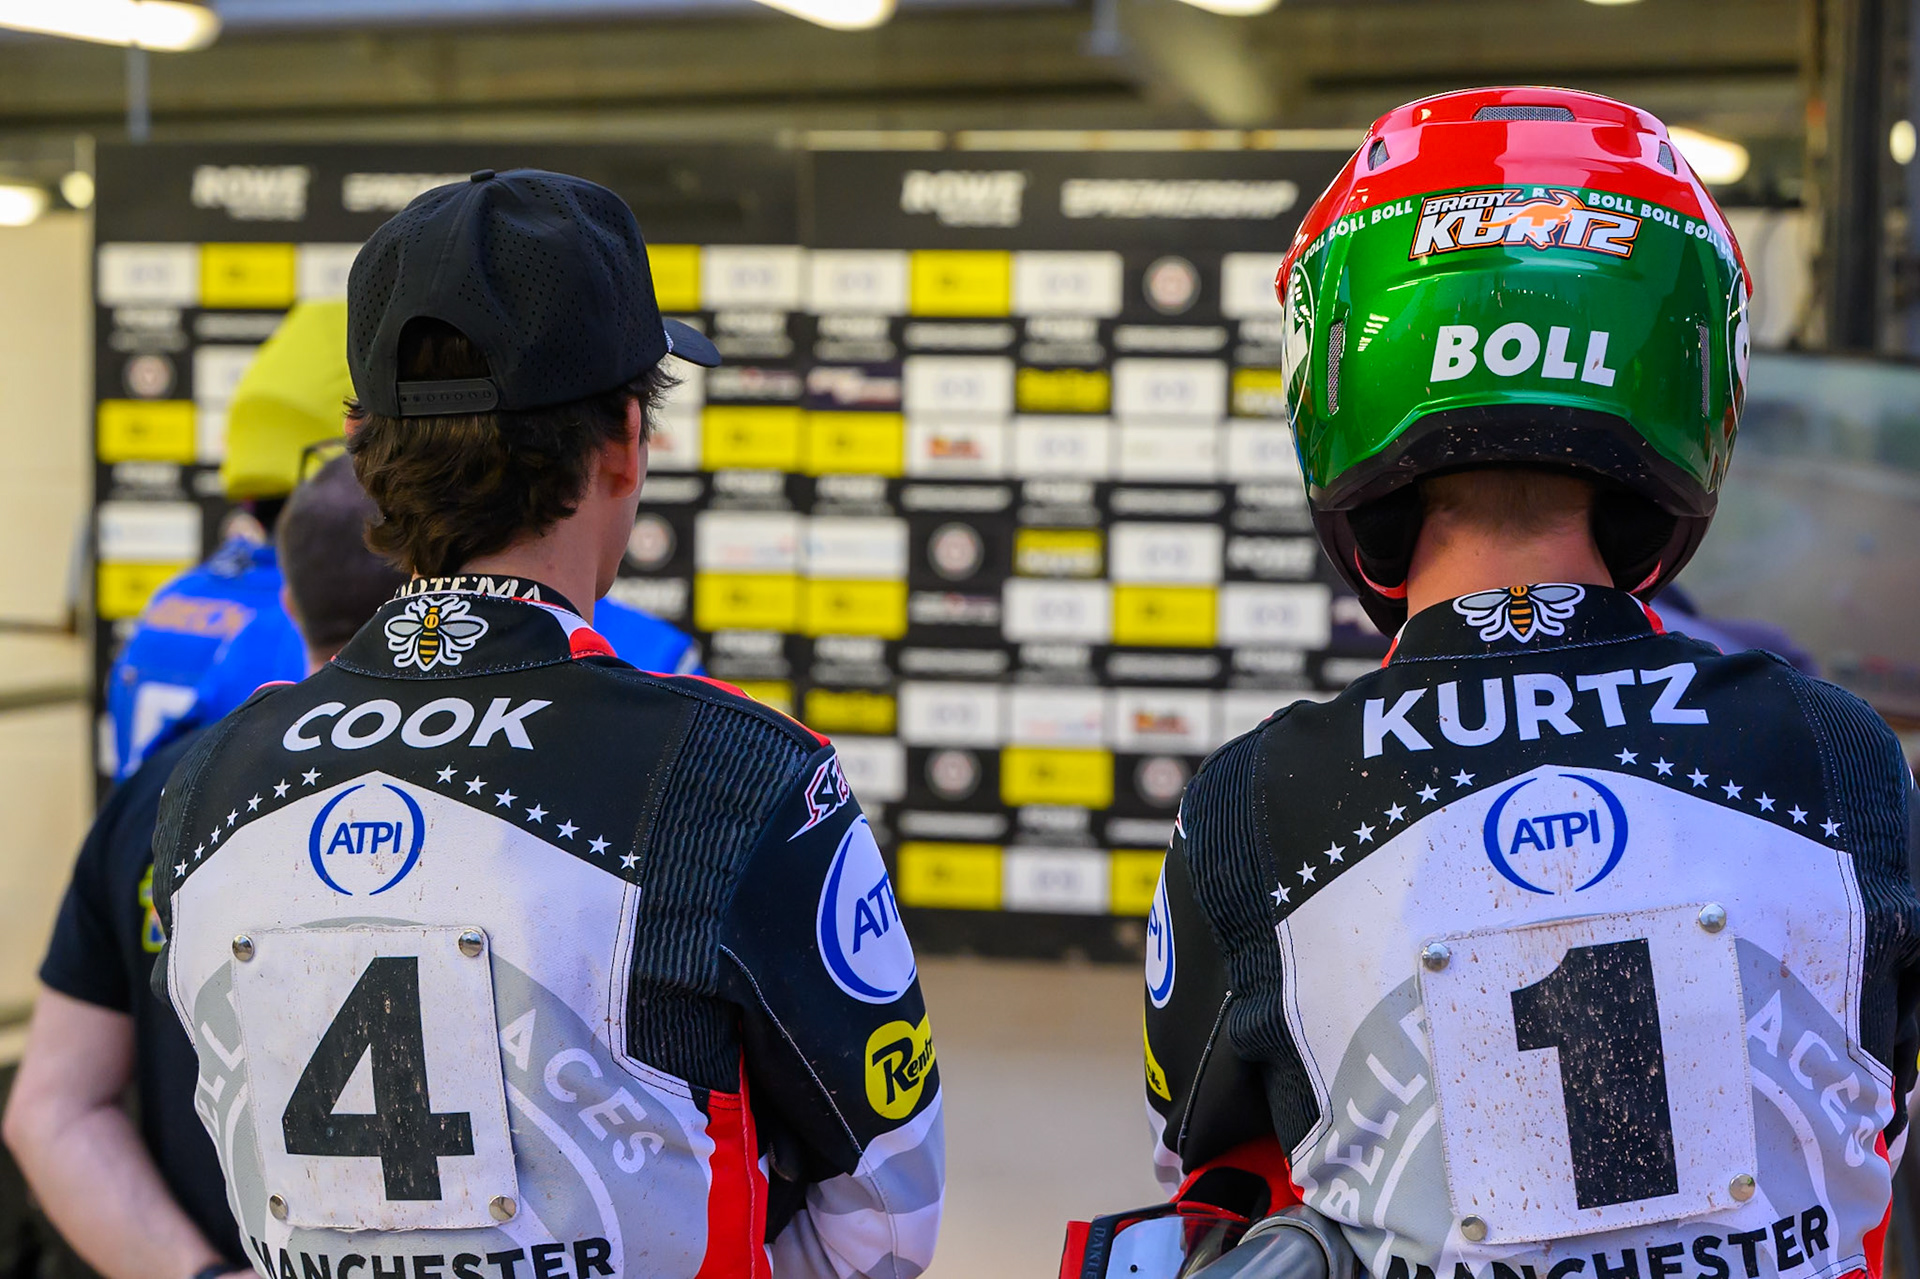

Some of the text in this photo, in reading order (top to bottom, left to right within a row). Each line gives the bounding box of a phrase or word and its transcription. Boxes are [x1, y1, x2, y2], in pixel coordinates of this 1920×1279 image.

[1328, 215, 1366, 242] BOLL
[1371, 200, 1413, 225] BOLL
[1588, 192, 1634, 213] BOLL
[1641, 203, 1681, 230] BOLL
[1684, 220, 1719, 247] BOLL
[1413, 206, 1637, 255] KURTZ
[1423, 190, 1512, 215] BRADY
[1430, 322, 1617, 387] BOLL
[282, 697, 553, 752] COOK
[1362, 662, 1709, 759] KURTZ
[326, 821, 403, 855] ATPI
[1509, 808, 1601, 856] ATPI
[282, 956, 474, 1200] 4
[500, 1009, 665, 1174] ACES
[1510, 937, 1678, 1210] 1
[1746, 989, 1876, 1167] ACES
